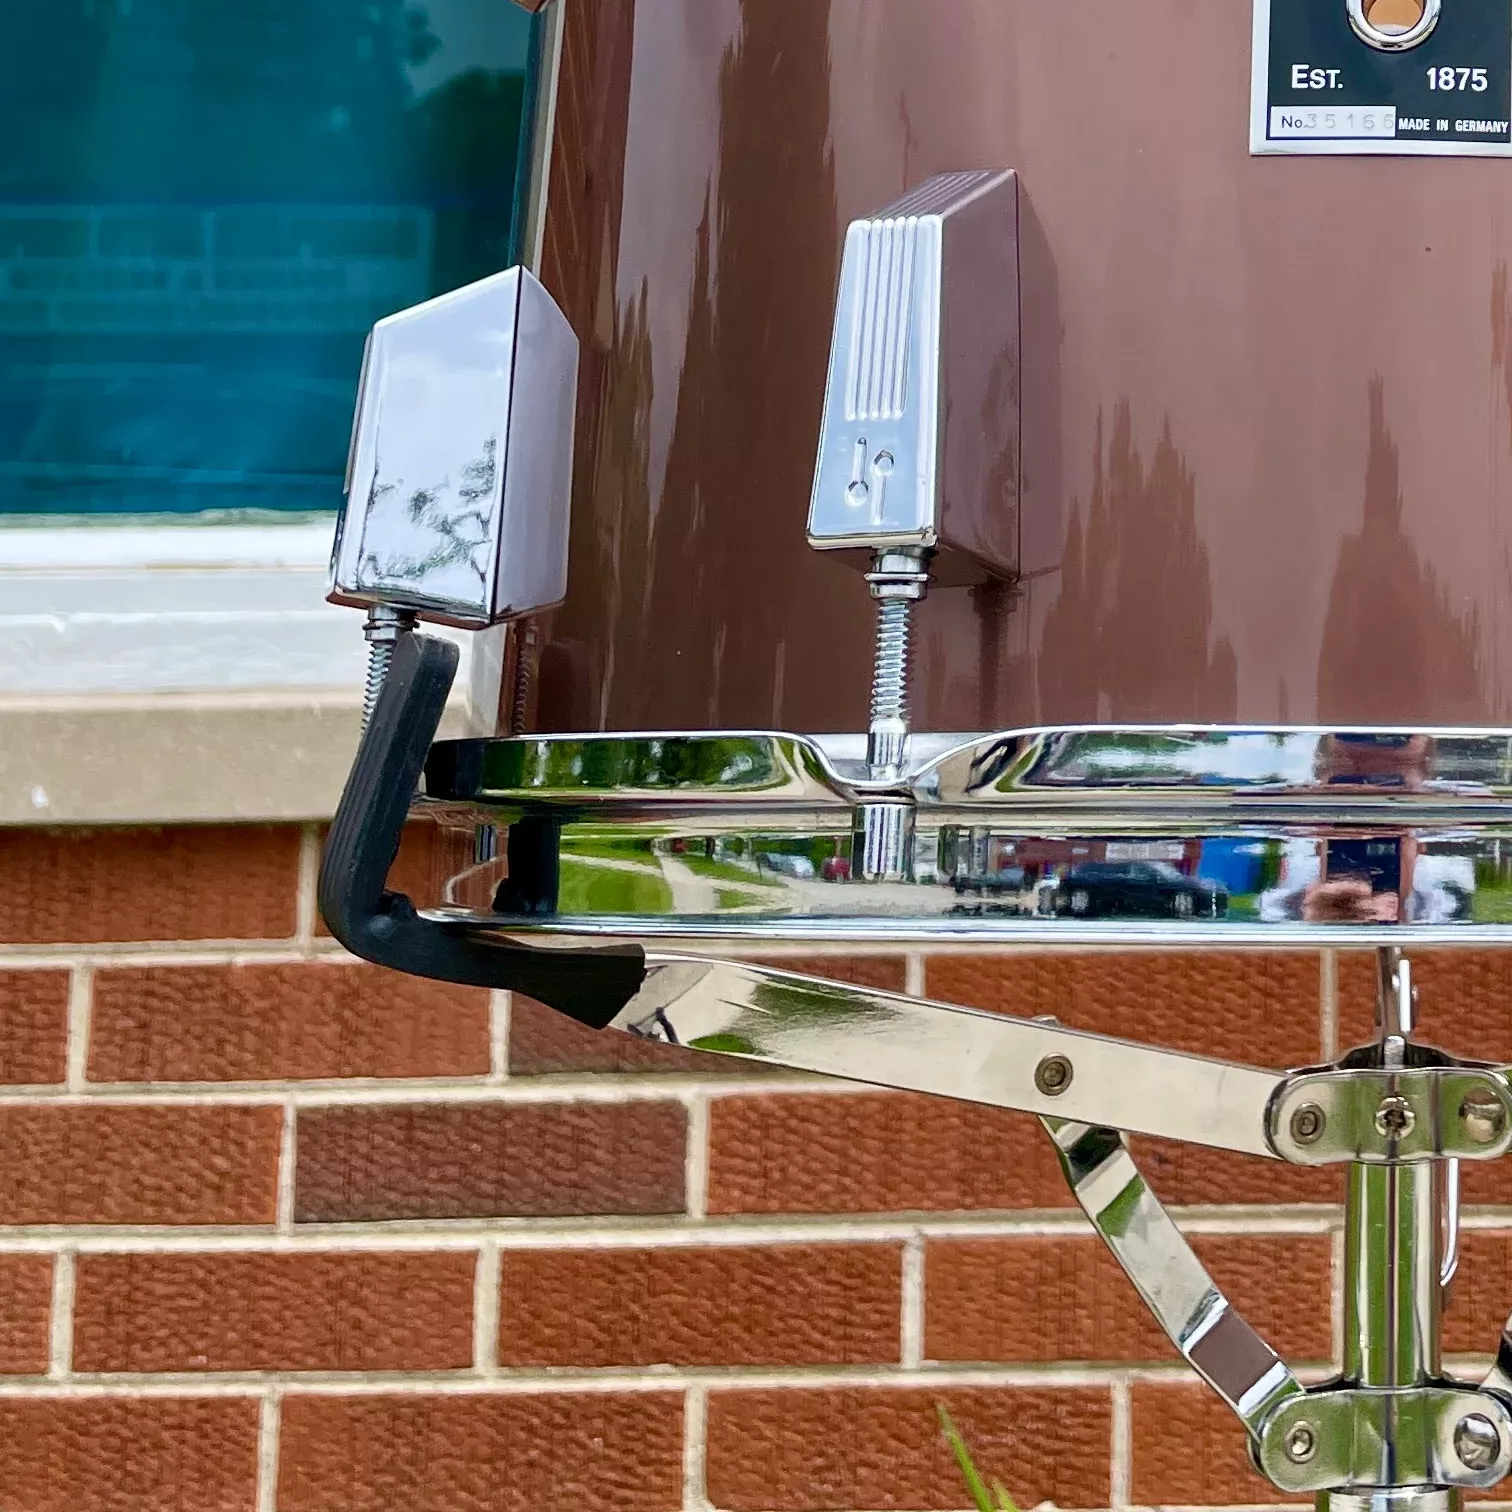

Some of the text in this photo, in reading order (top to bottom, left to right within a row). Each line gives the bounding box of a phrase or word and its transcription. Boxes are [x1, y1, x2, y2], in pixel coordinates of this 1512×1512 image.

[1291, 64, 1488, 92] EST. 1875
[1398, 117, 1509, 134] MADE IN GERMANY
